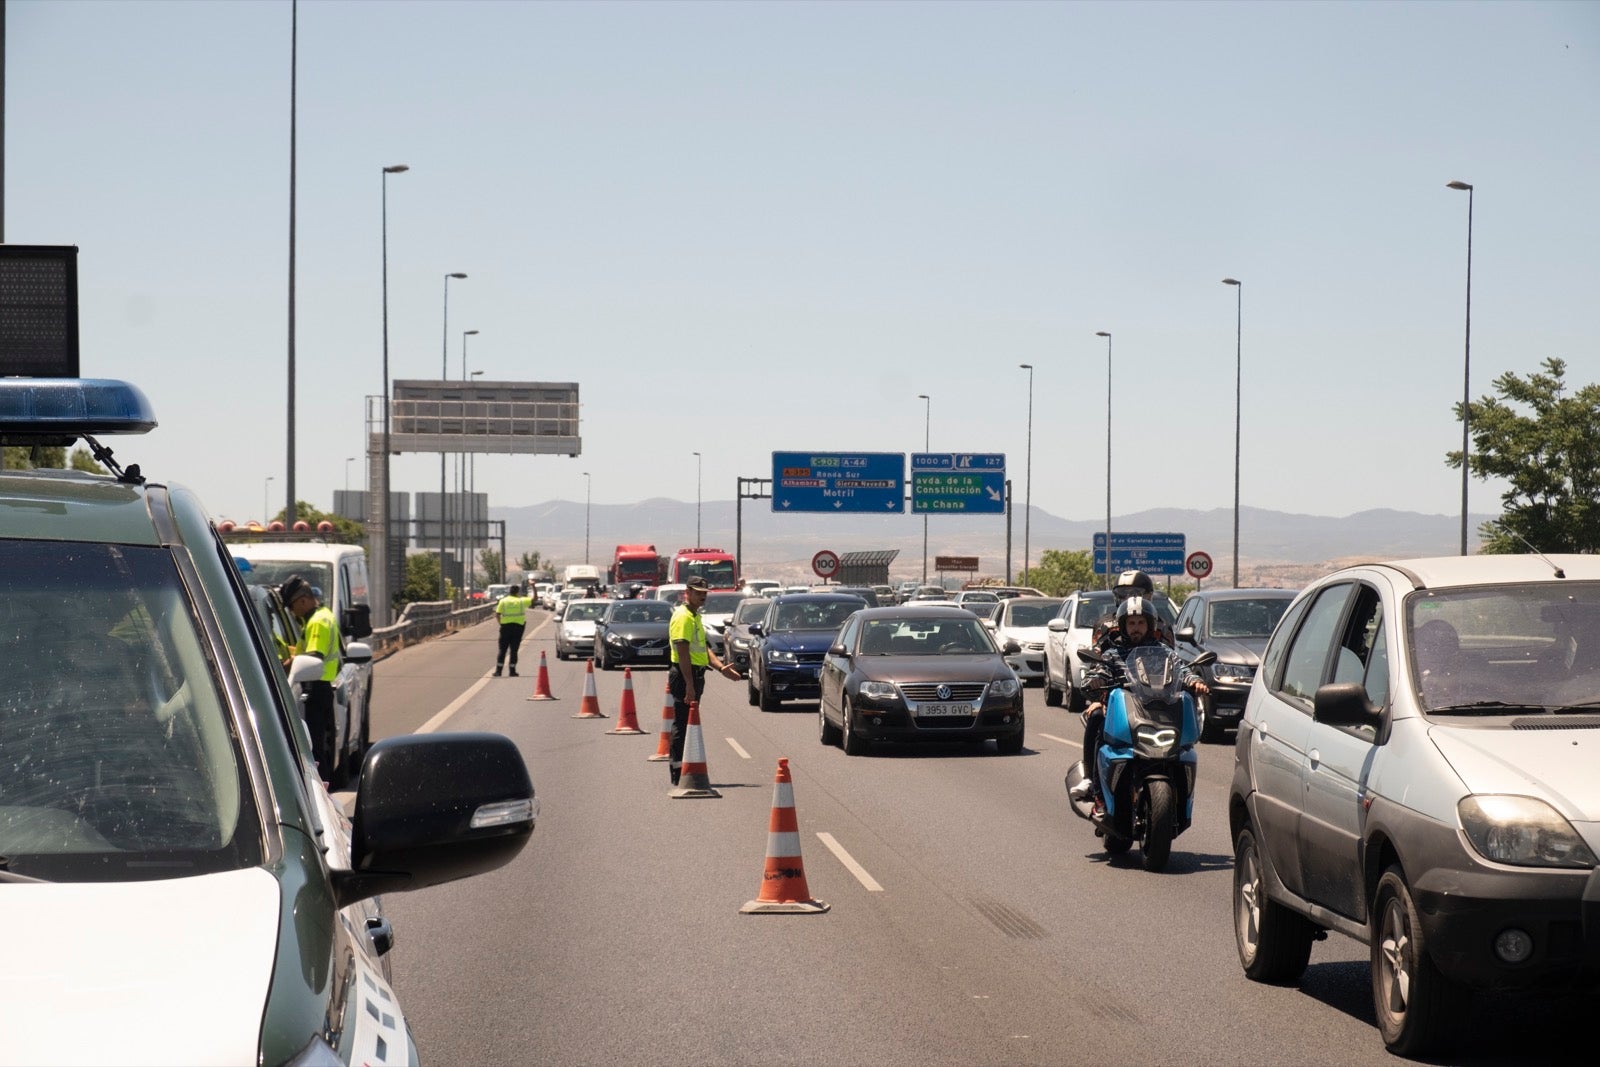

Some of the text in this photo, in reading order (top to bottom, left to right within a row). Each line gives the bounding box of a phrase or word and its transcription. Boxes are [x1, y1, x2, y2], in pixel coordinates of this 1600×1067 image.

[843, 458, 866, 466] A-44
[916, 457, 939, 465] 1000
[946, 477, 959, 485] de
[963, 477, 972, 485] la
[823, 489, 854, 497] Motril
[915, 485, 981, 494] Constitución
[933, 500, 965, 508] Chana
[817, 559, 835, 569] 100
[1190, 560, 1209, 570] 100
[925, 704, 969, 715] 3953 GVC
